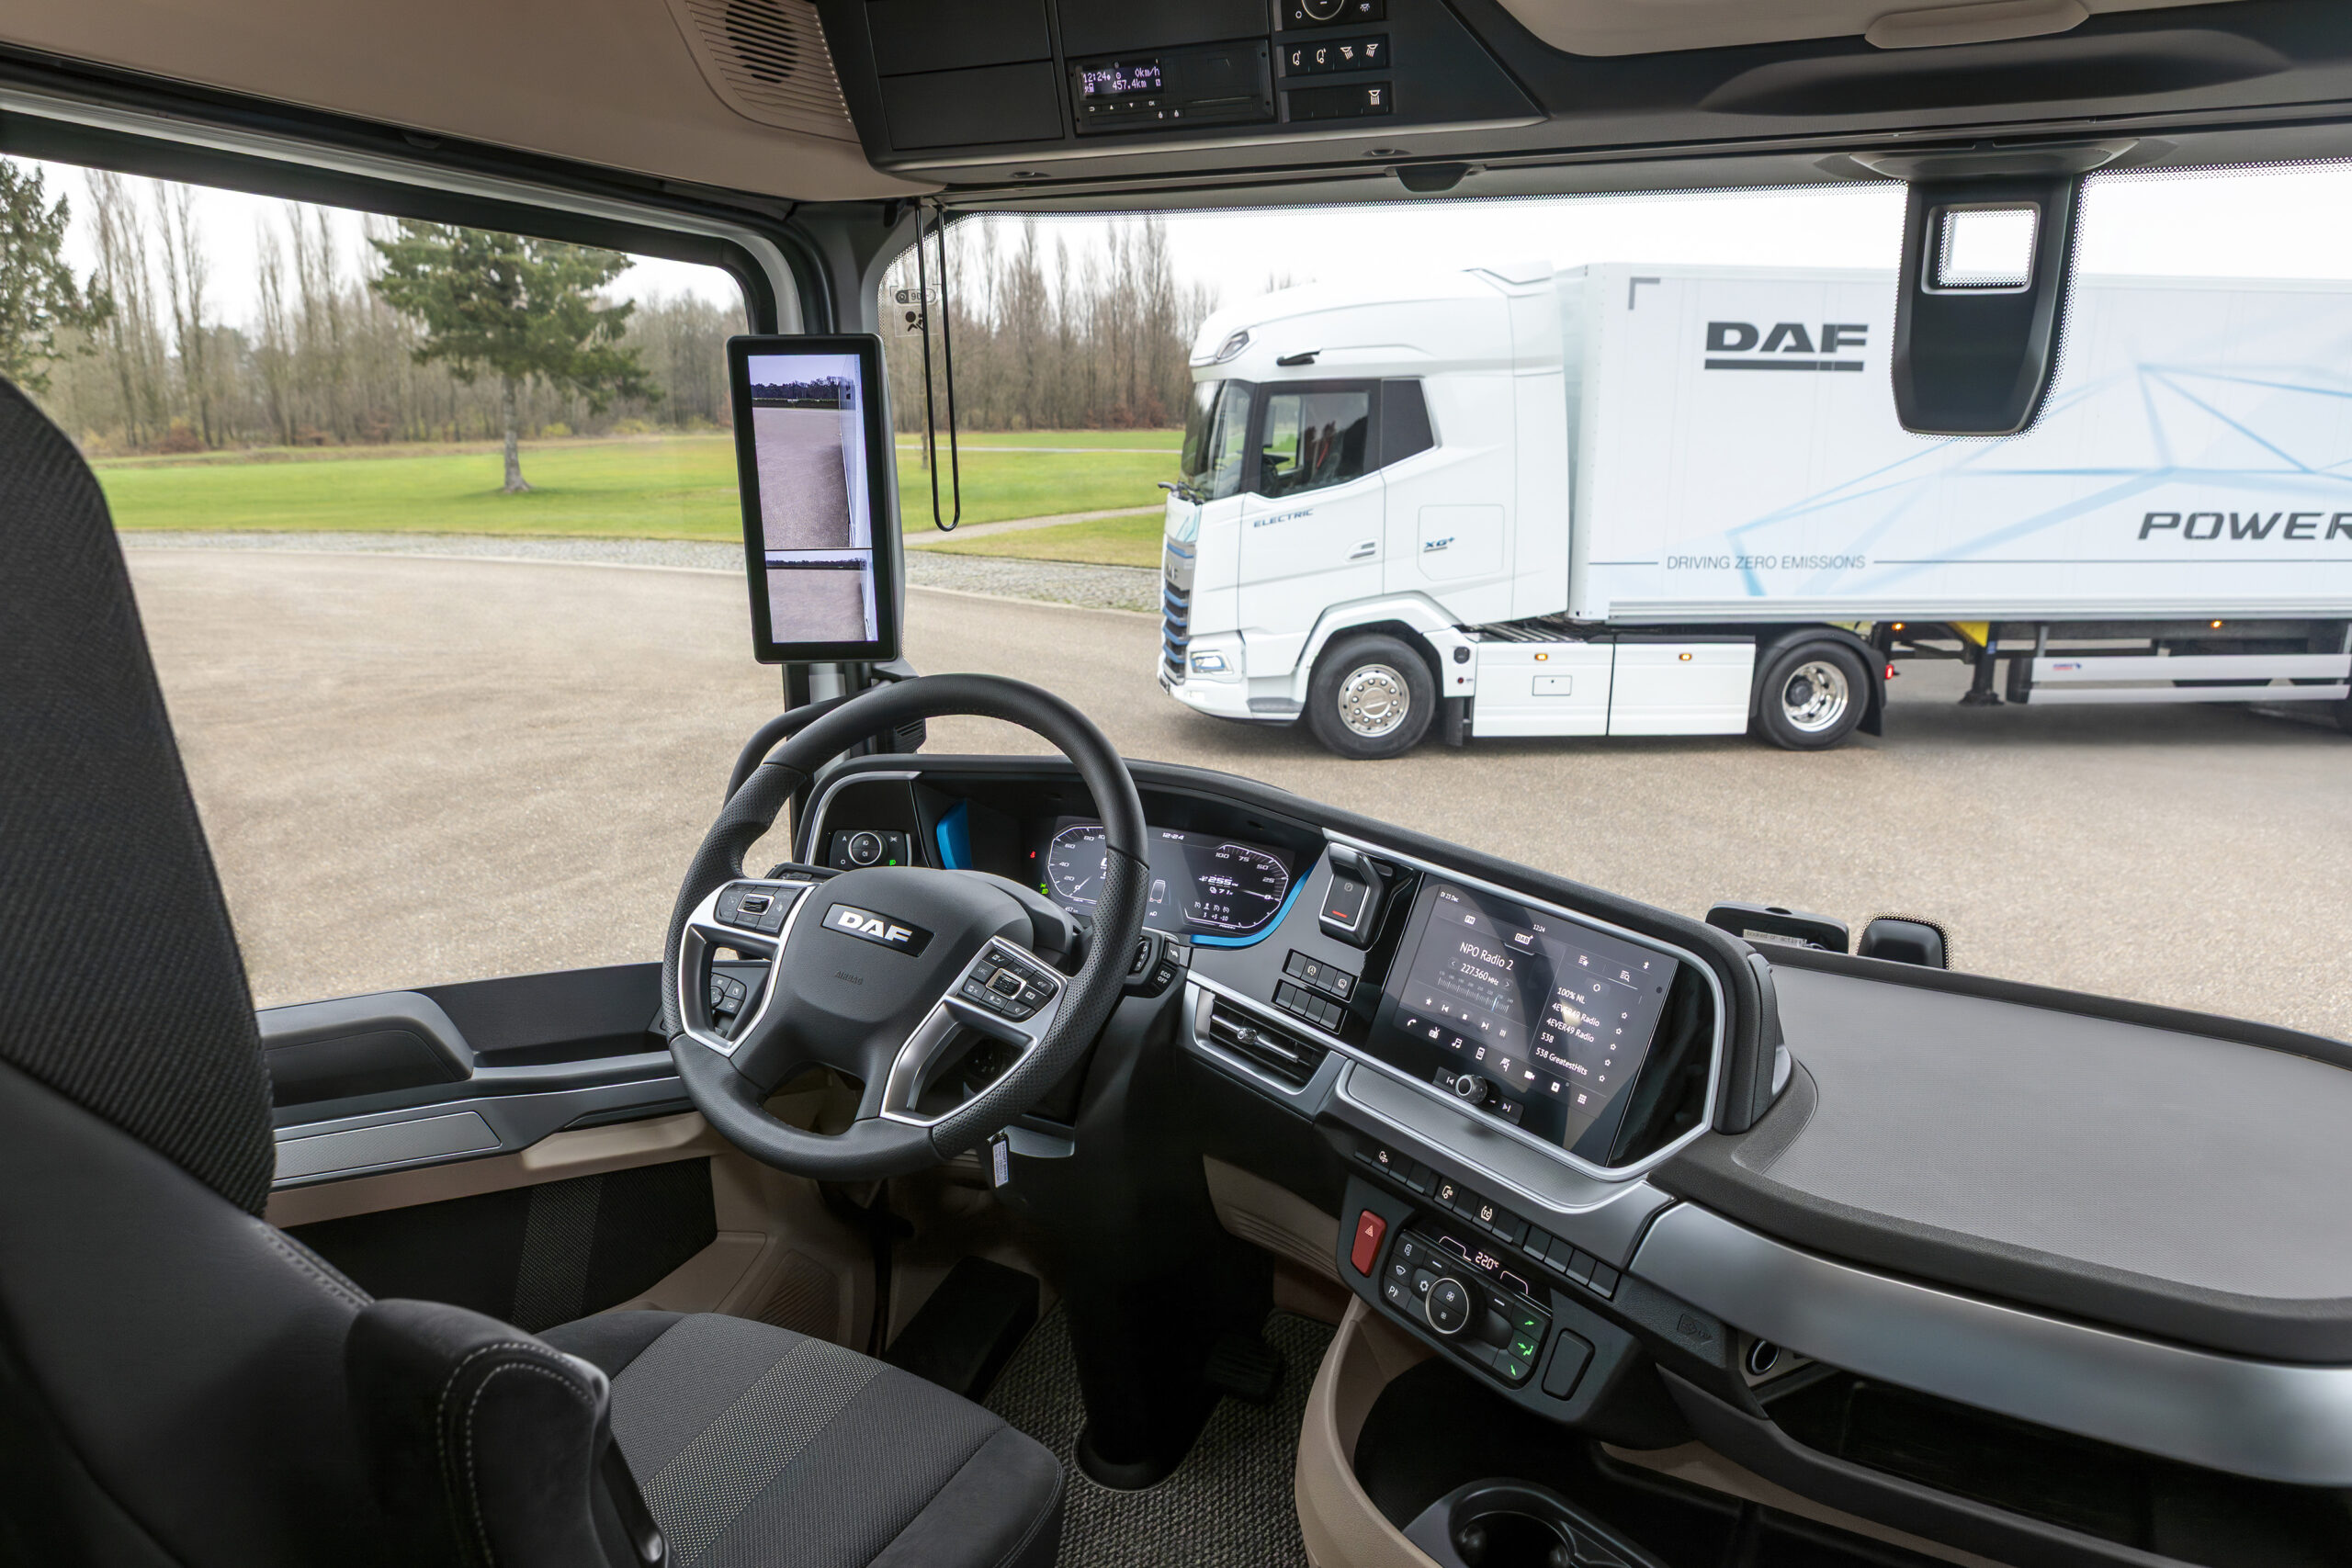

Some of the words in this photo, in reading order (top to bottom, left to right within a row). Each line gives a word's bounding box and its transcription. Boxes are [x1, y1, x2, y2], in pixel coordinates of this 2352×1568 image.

[1083, 72, 1108, 84] 12:24
[1112, 79, 1148, 91] 457.4km
[1706, 321, 1869, 354] DAF
[1253, 508, 1315, 528] ELECTRIC
[2137, 512, 2352, 540] POWER
[1667, 555, 1731, 570] DRIVING
[1734, 555, 1778, 570] ZERO
[1781, 554, 1867, 570] EMISSIONS
[1162, 832, 1185, 840] 12:24
[1207, 875, 1233, 886] 255
[837, 910, 913, 942] DAF
[1532, 923, 1545, 933] 12:24
[1459, 942, 1480, 958] NPO
[1480, 950, 1505, 968] Radio
[1506, 959, 1514, 971] 2
[834, 971, 864, 986] AIRBAG
[1157, 976, 1168, 984] OFF
[1160, 970, 1171, 979] ECO
[1460, 963, 1488, 981] 227.360
[1556, 987, 1577, 1000] 100%
[1576, 994, 1586, 1005] NL
[1551, 1002, 1581, 1019] 4EVER49
[1580, 1013, 1600, 1027] Radio
[1540, 1032, 1555, 1043] 538
[1546, 1018, 1576, 1034] 4EVER49
[1575, 1029, 1595, 1043] Radio
[1535, 1047, 1549, 1059] 538
[1548, 1054, 1589, 1076] GreatestHits
